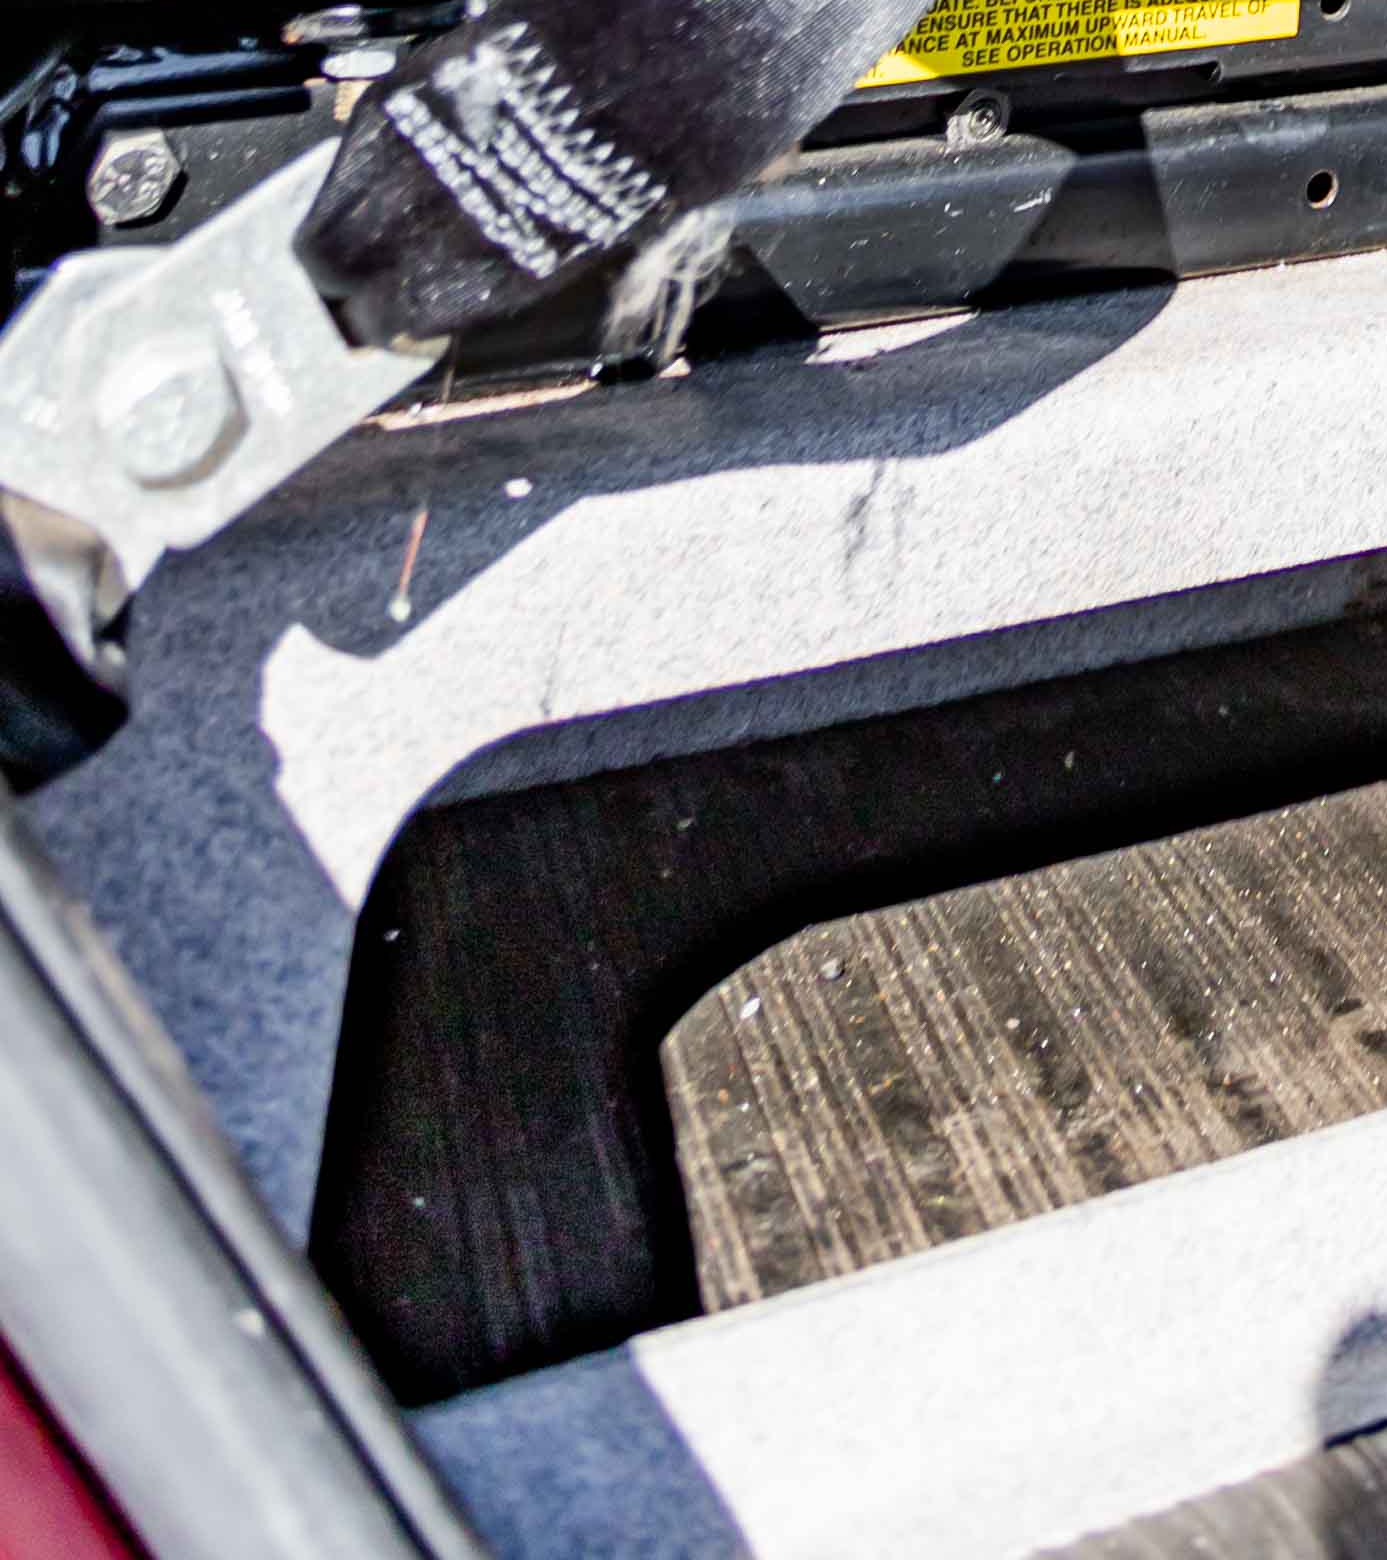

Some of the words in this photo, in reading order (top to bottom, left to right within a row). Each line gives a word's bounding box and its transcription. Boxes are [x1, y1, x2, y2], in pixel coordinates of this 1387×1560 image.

[916, 10, 1002, 35] ENSURE
[1005, 2, 1050, 23] THAT
[955, 32, 979, 51] AT
[986, 20, 1080, 46] MAXIMUM
[1085, 8, 1168, 35] UPWARD
[1173, 1, 1241, 25] TRAVEL
[961, 49, 1001, 69] SEE
[1007, 34, 1118, 63] OPERATION
